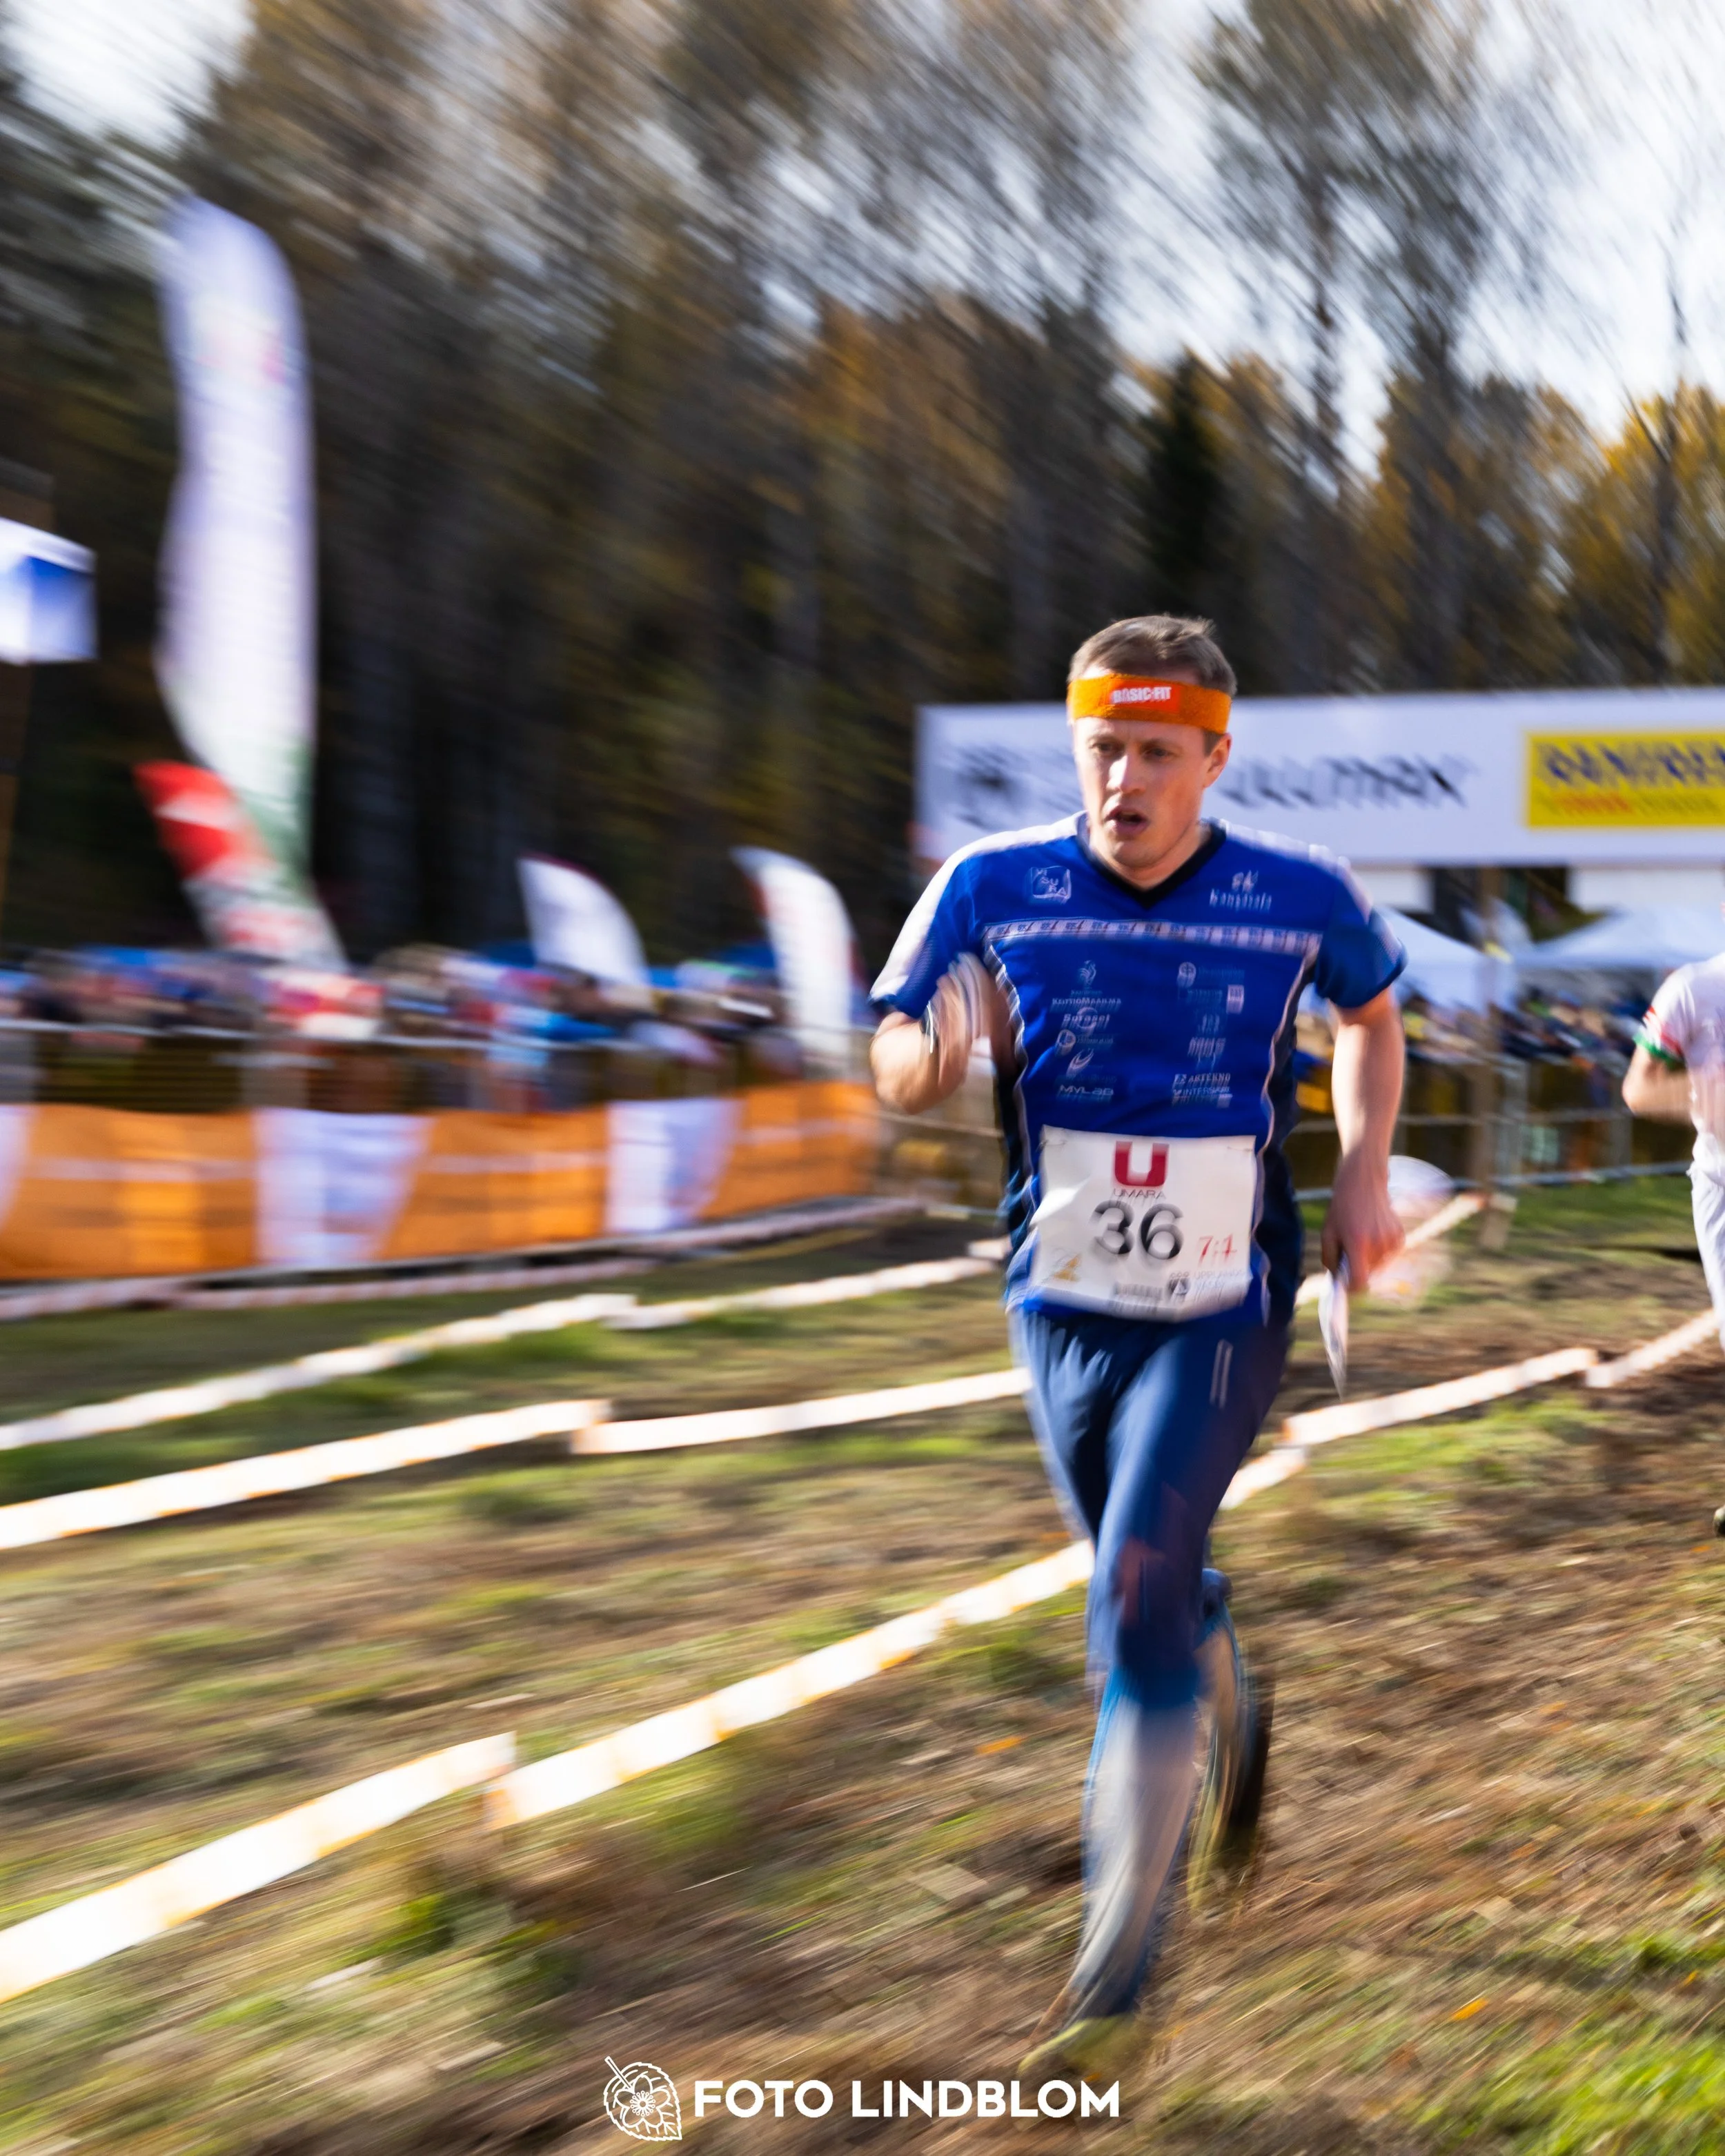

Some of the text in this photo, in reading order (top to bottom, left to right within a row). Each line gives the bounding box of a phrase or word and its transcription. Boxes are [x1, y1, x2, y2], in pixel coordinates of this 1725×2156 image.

[1041, 877, 1059, 886] SU
[1114, 1140, 1170, 1187] U
[1113, 1188, 1166, 1199] UMARA
[1094, 1200, 1183, 1260] 36
